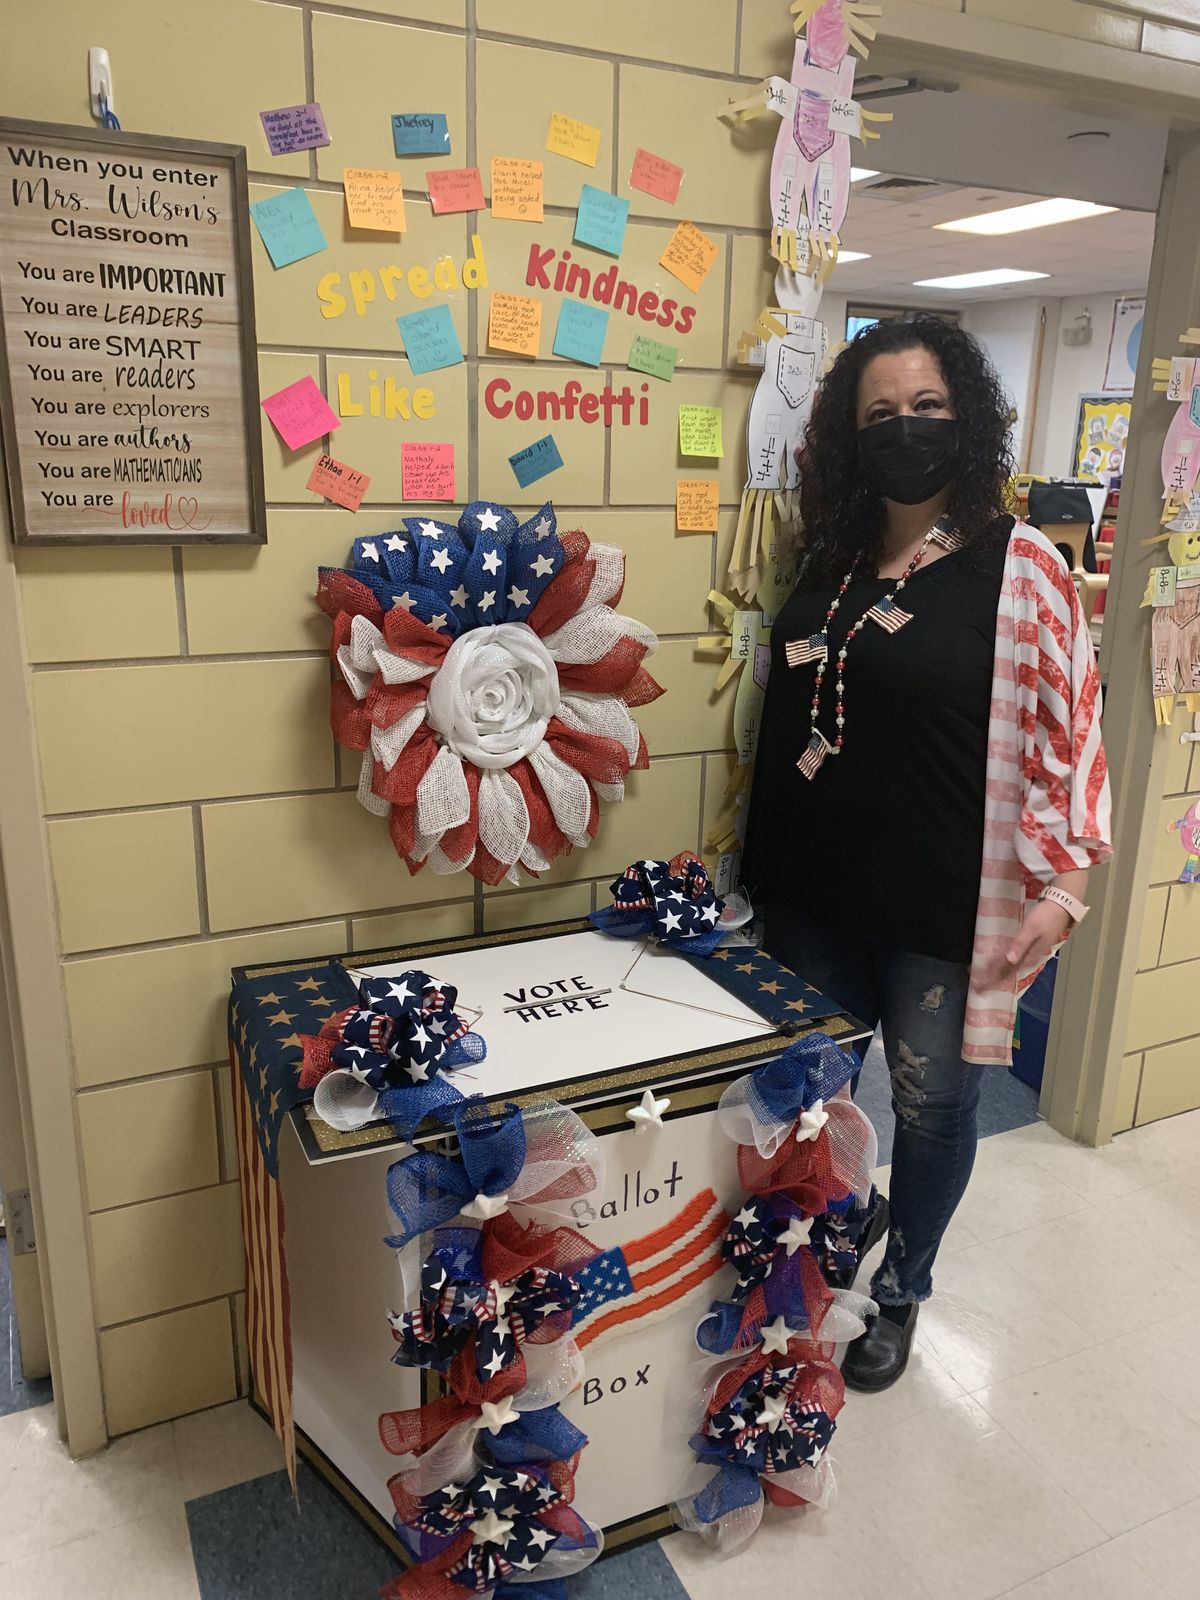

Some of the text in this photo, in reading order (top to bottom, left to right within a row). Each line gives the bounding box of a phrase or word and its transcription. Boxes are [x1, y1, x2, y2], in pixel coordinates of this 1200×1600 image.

[7, 147, 218, 188] When you enter
[346, 170, 373, 180] Class
[494, 158, 519, 167] Class
[12, 177, 222, 226] Mrs. Wilson's
[51, 218, 189, 248] Classroom
[17, 261, 226, 298] You are IMPORTANT
[316, 234, 698, 335] Spread Kindness
[21, 296, 204, 329] You are LEADERS
[24, 330, 201, 360] You are SMART
[27, 357, 196, 390] You are readers
[31, 394, 210, 424] You are explorers
[337, 369, 650, 427] Like Confetti
[34, 425, 192, 454] You are authors
[404, 444, 427, 452] Class
[38, 457, 203, 484] You are MATHEMATICIANS
[318, 455, 362, 485] Ethan 1-1
[404, 464, 431, 472] helped
[756, 436, 776, 481] 4+4=
[41, 491, 77, 507] You
[83, 494, 114, 507] are
[1160, 568, 1170, 593] 8+8=
[738, 626, 750, 656] 8+8=
[503, 975, 594, 1004] VOTE
[516, 995, 610, 1024] HERE
[570, 1160, 684, 1229] Ballot
[583, 1363, 651, 1407] Box
